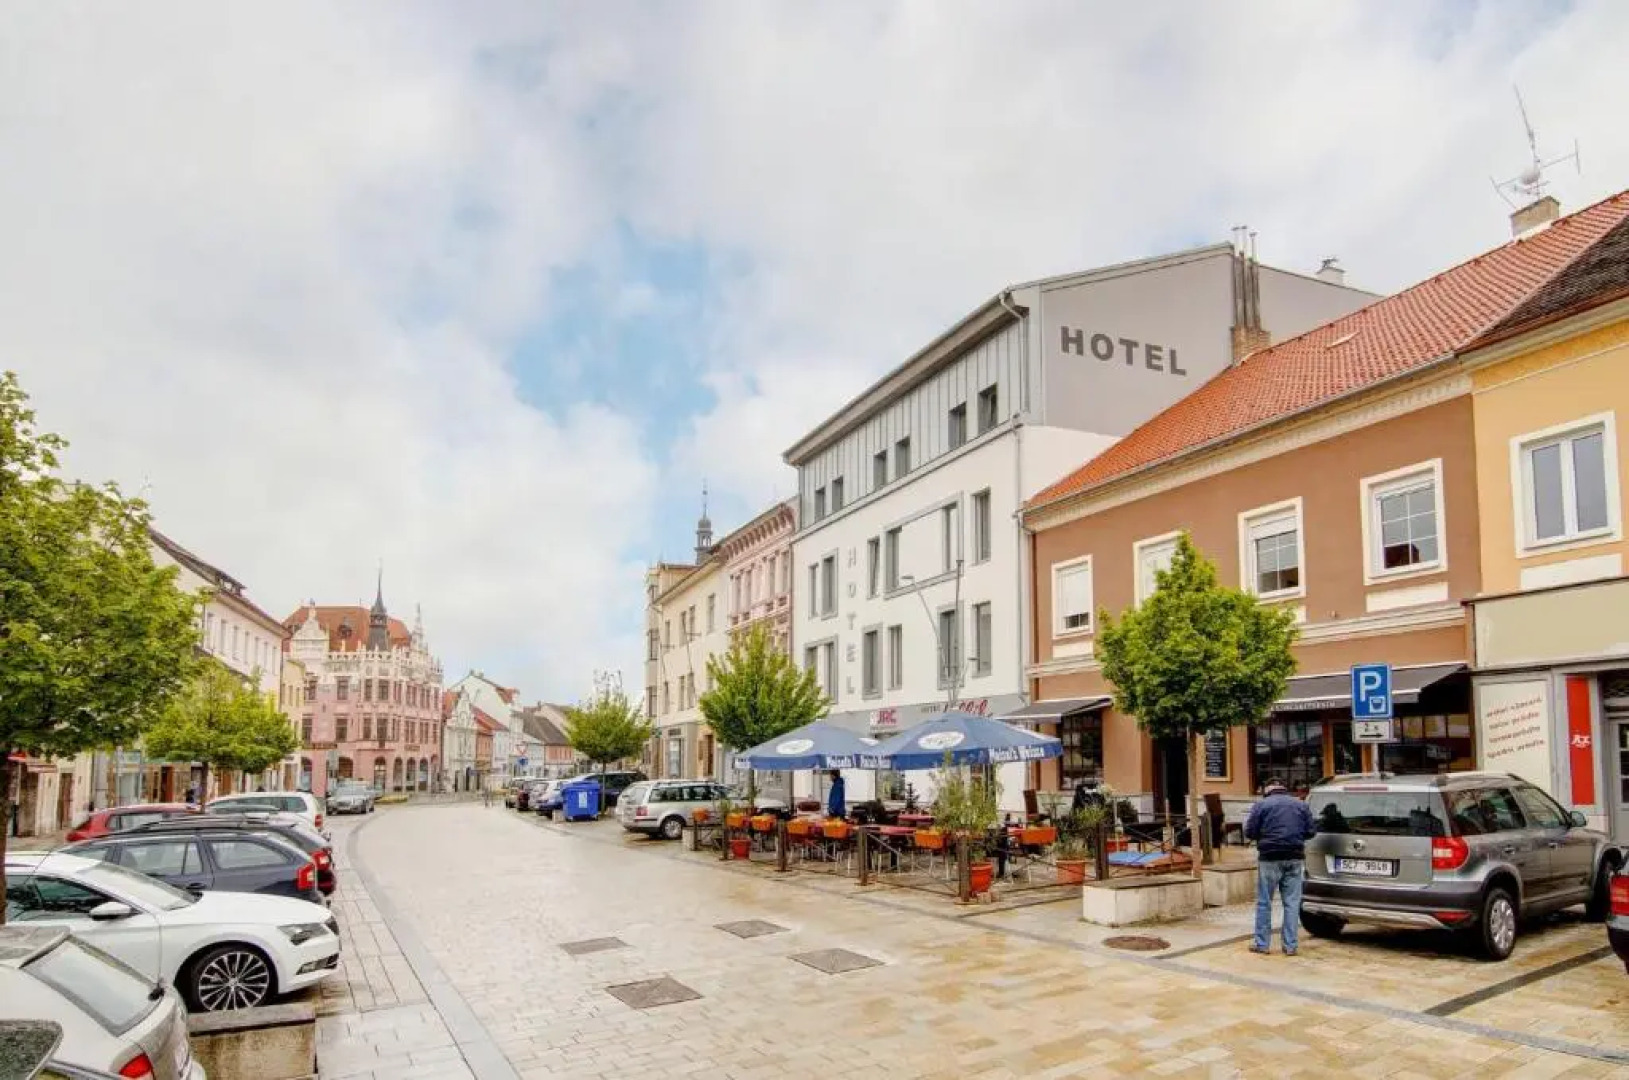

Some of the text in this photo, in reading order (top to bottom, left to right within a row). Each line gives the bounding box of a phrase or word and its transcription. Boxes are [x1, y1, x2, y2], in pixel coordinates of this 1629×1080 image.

[1061, 325, 1187, 376] HOTEL
[847, 547, 857, 694] HOTEL
[1359, 671, 1382, 702] P
